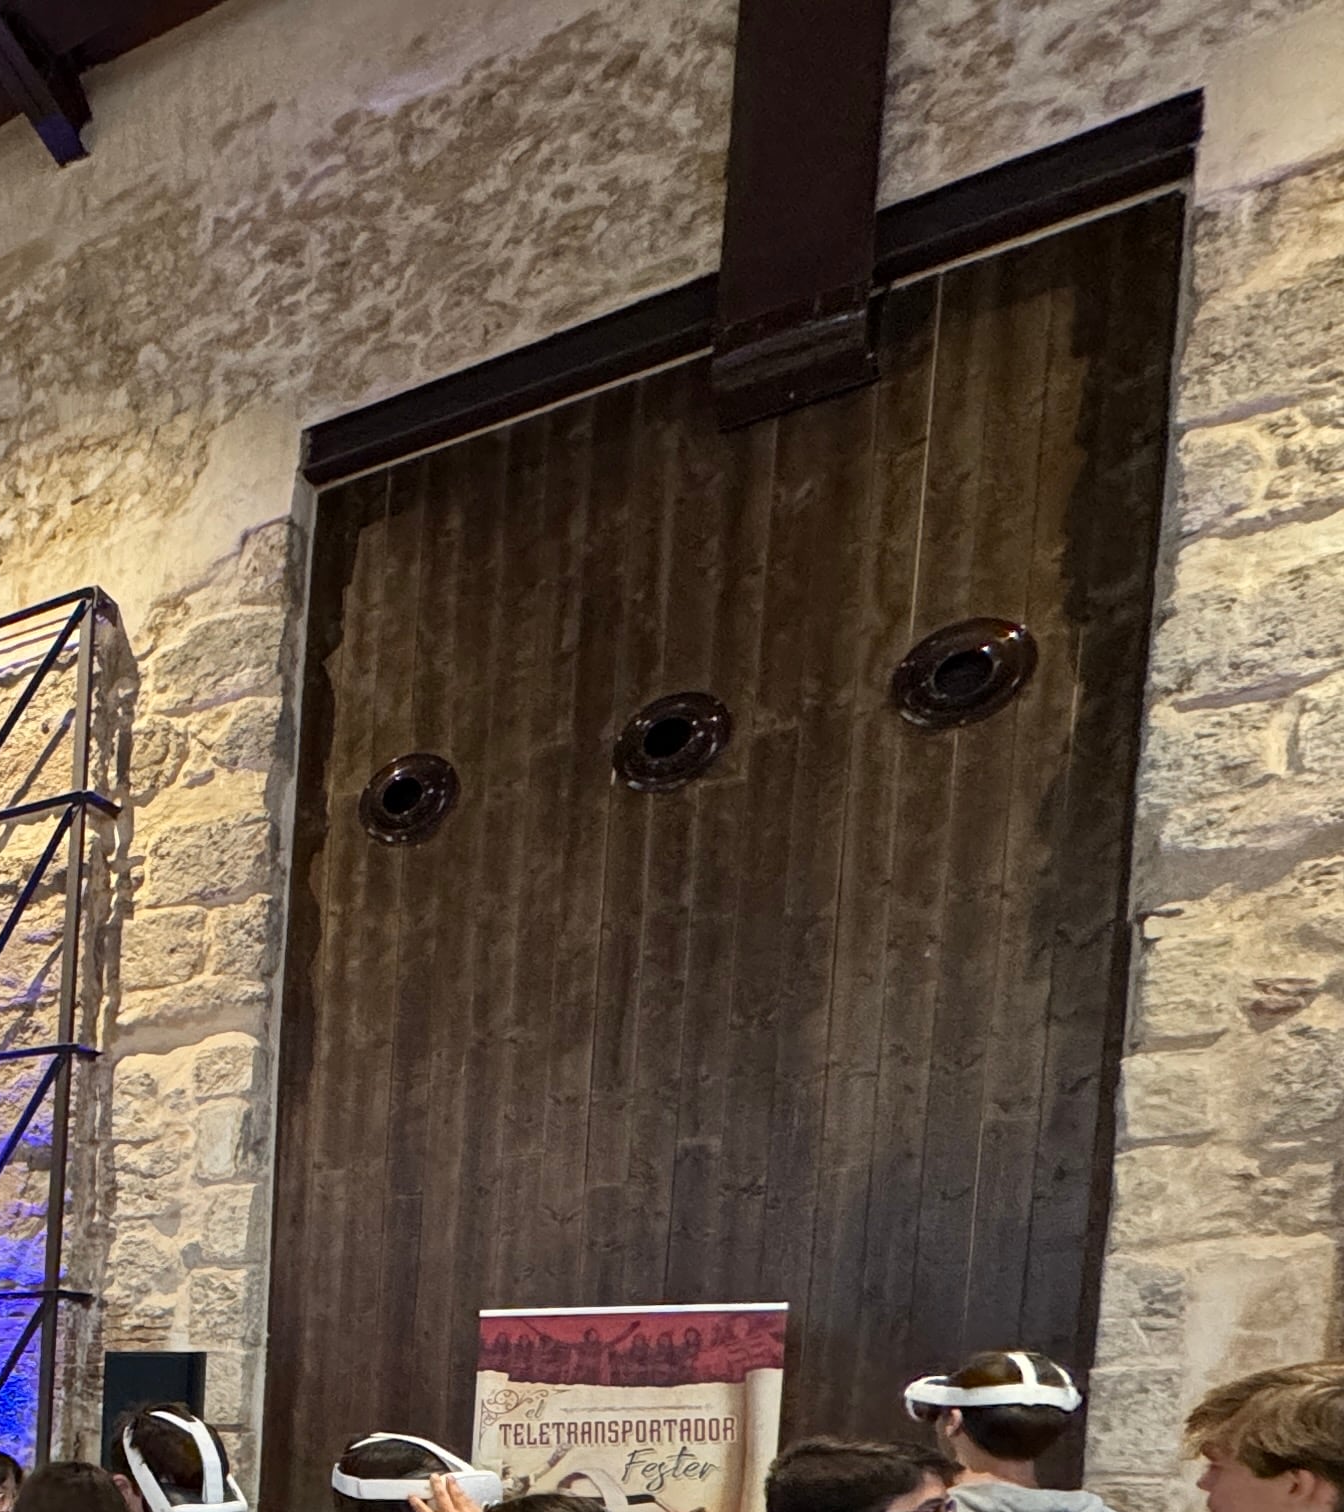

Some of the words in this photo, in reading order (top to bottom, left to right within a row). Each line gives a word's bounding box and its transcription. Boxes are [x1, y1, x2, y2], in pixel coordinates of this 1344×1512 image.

[524, 1399, 544, 1418] el
[498, 1417, 735, 1446] TELETRANSPORTADOR
[621, 1446, 720, 1492] Fester
